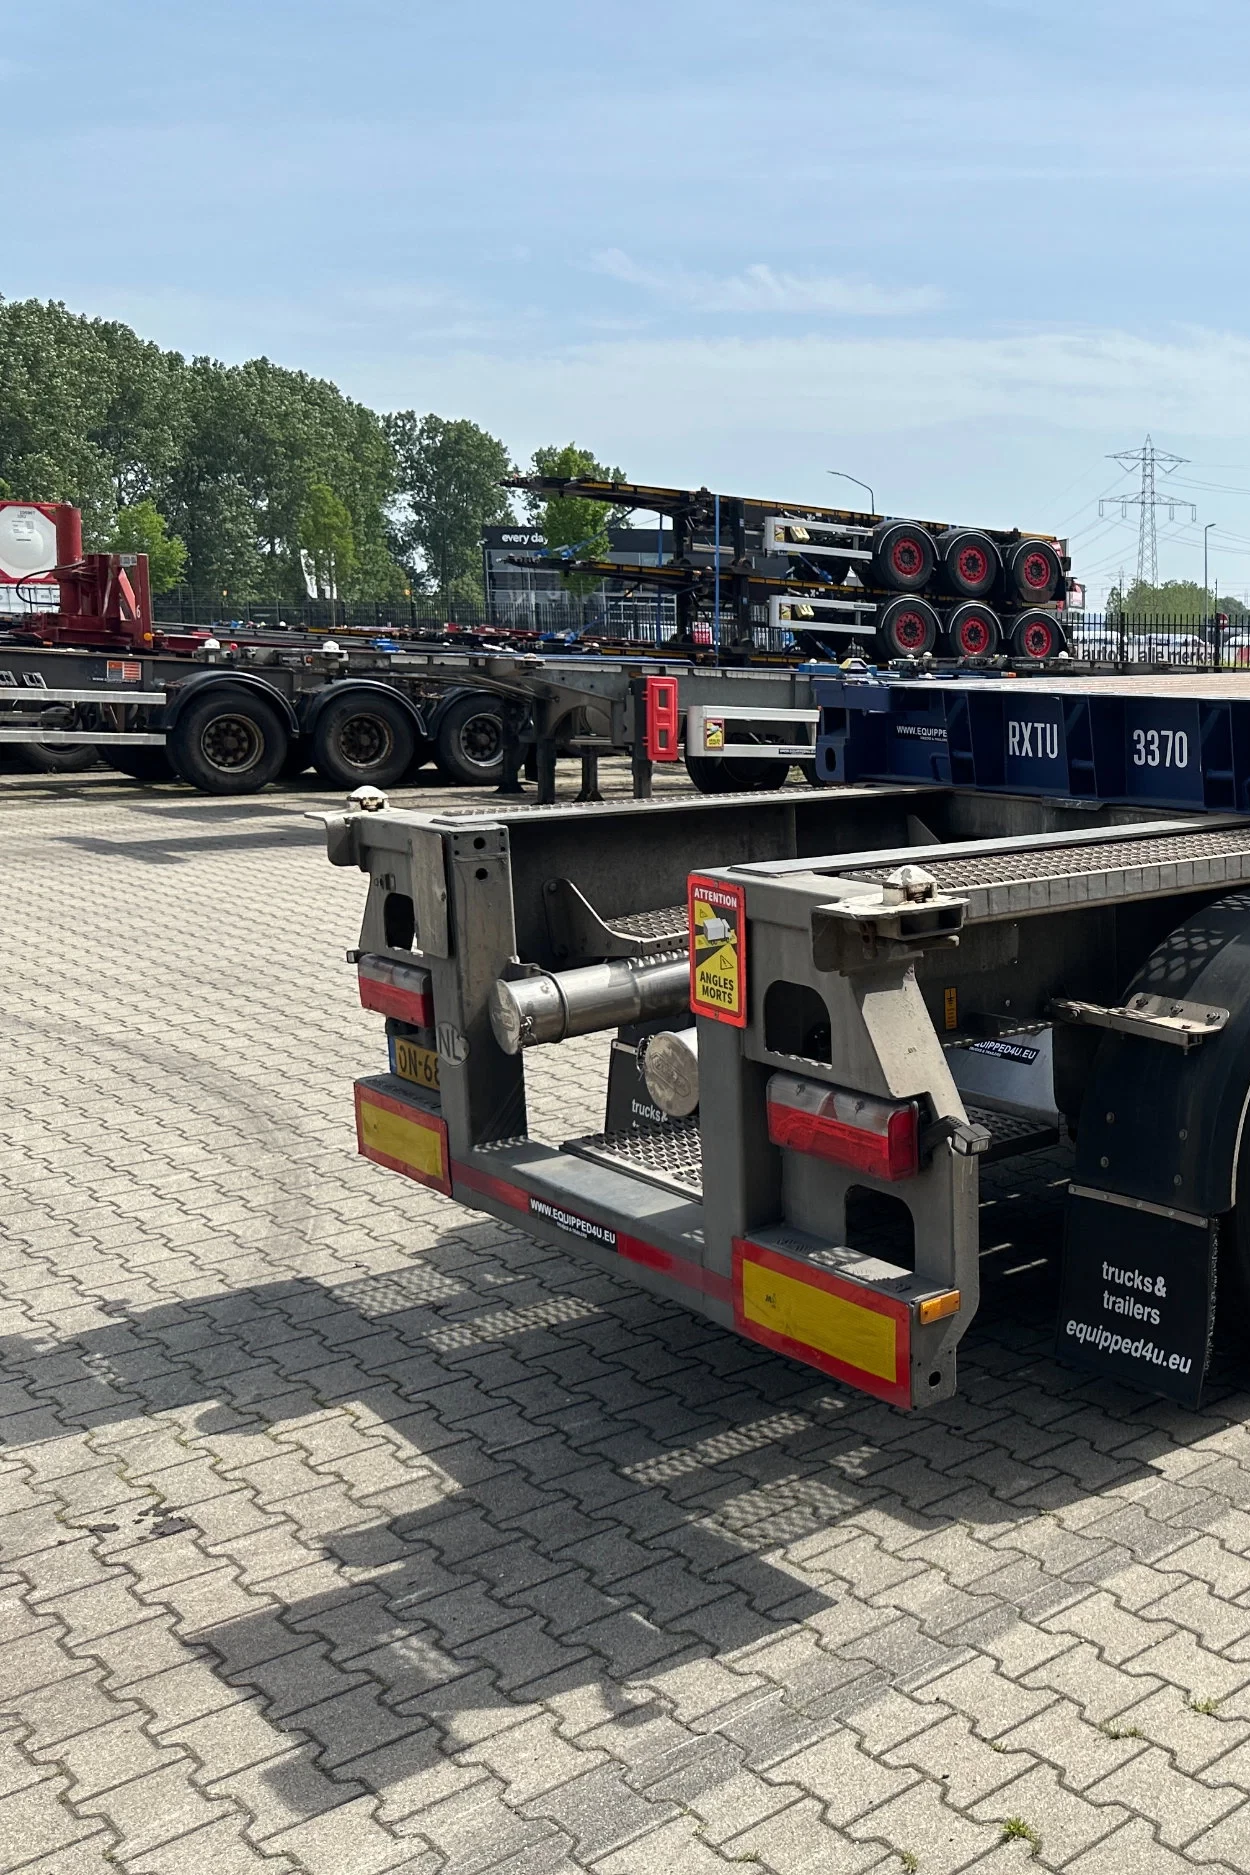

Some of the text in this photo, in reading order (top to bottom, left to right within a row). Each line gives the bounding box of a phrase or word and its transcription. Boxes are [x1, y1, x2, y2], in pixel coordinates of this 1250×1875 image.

[501, 533, 549, 545] every day
[1007, 720, 1059, 760] RXTU
[1132, 729, 1189, 768] 3370
[694, 887, 738, 908] ATTENTION
[699, 970, 734, 992] ANGLES
[701, 983, 733, 1005] MORTS
[439, 1026, 462, 1062] NL
[530, 1198, 616, 1244] WWW.EQUIPPED4U.EU
[1103, 1290, 1161, 1325] trailers
[1066, 1319, 1192, 1374] equipped4u.eu
